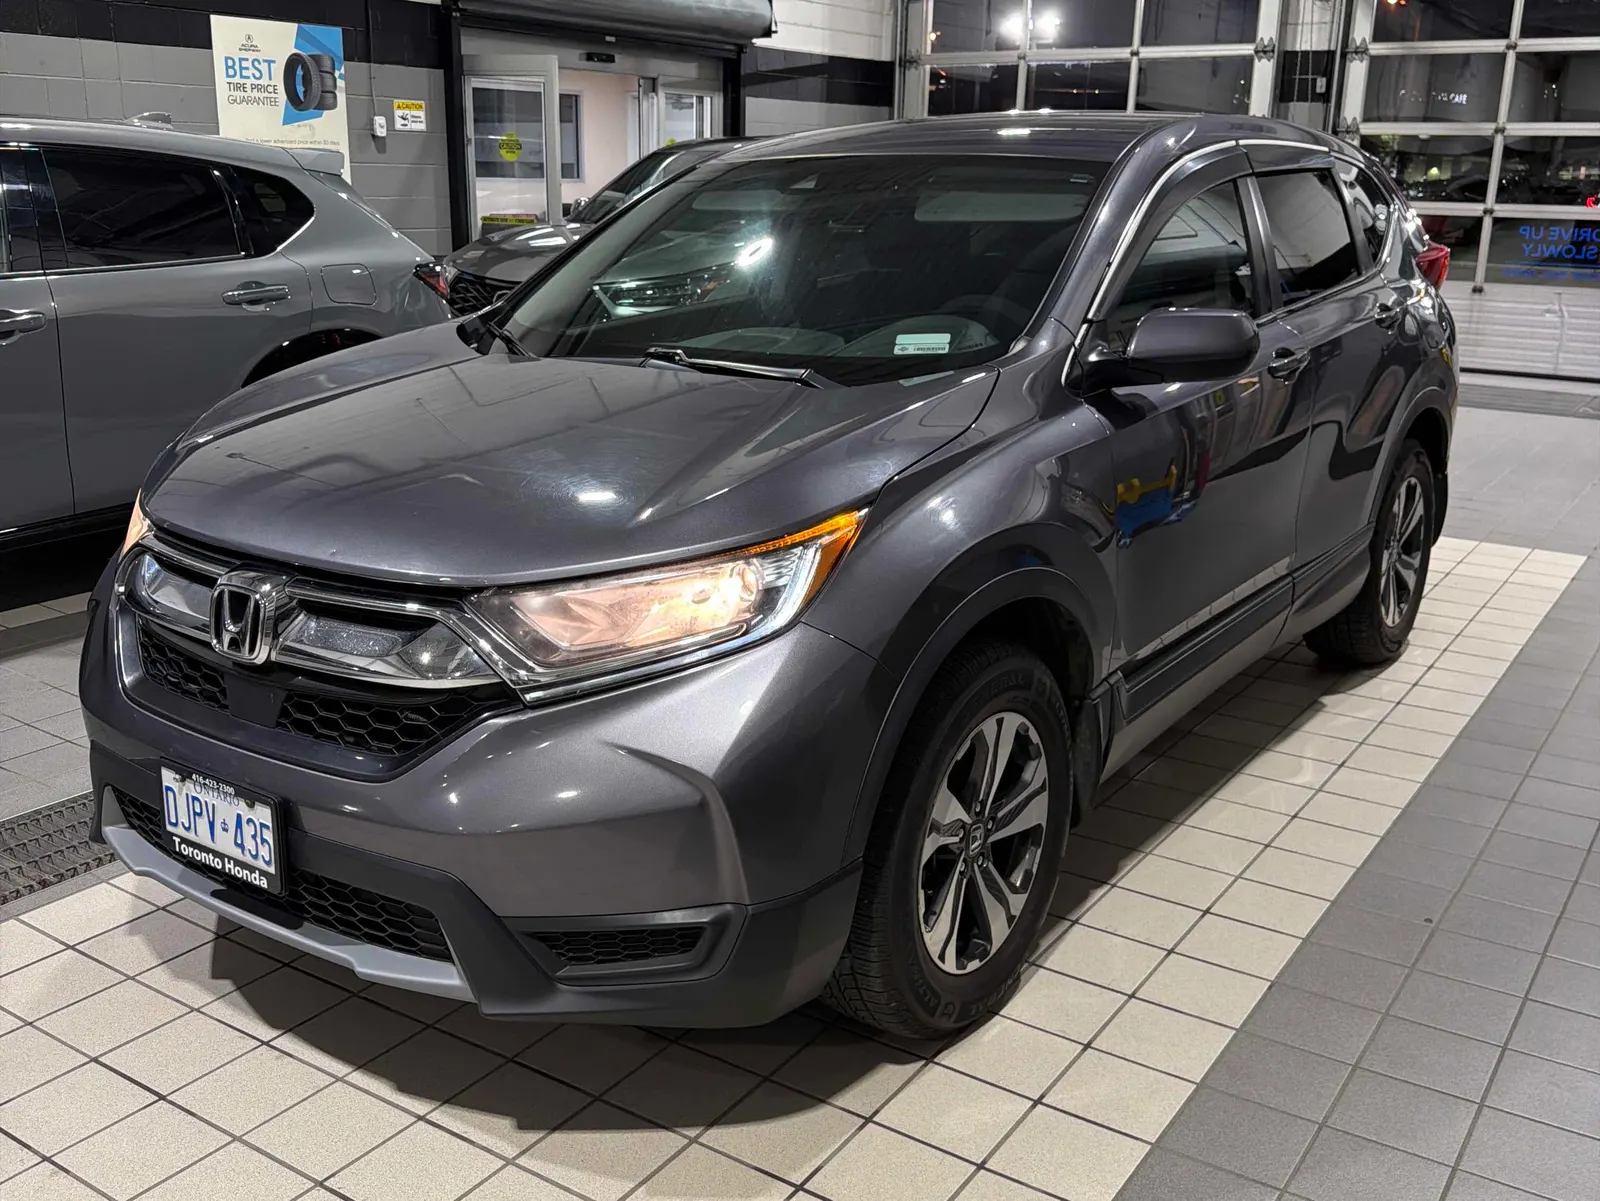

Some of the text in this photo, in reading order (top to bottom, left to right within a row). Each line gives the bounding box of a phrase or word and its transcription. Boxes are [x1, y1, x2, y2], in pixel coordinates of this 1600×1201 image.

[224, 56, 276, 81] BEST
[226, 81, 279, 95] TIRE PRICE
[227, 94, 280, 107] GUARANTEE
[192, 773, 236, 795] 416-423-2300
[164, 784, 273, 867] DJPV 435
[172, 836, 268, 889] Toronto Honda
